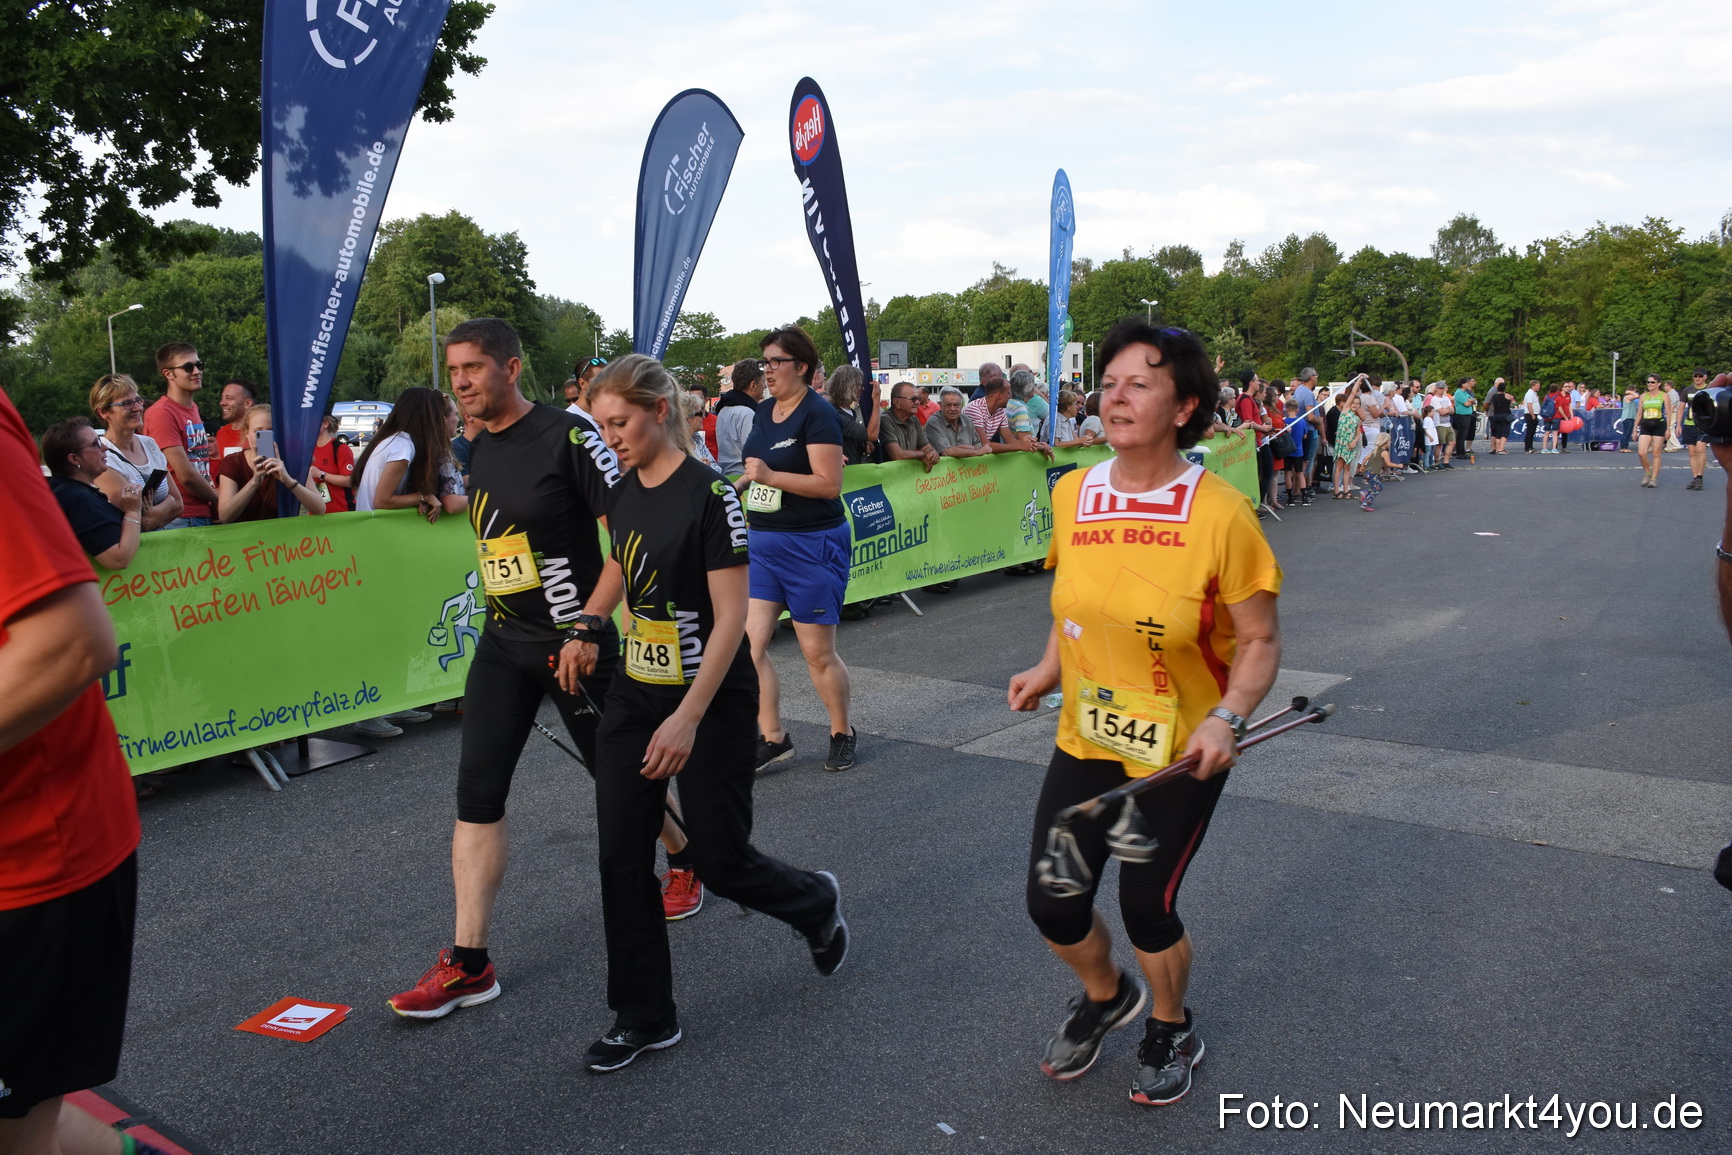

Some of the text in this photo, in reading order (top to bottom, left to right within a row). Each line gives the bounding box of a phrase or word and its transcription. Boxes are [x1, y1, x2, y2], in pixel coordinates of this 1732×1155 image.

[674, 122, 710, 201] Fischer
[688, 136, 715, 200] AUTOMOBILE
[301, 141, 386, 409] www.fischer-automobile.de
[749, 487, 776, 503] 1387
[857, 500, 884, 515] Fischer
[1071, 525, 1186, 547] MAX BÖGL
[242, 536, 334, 572] Firmen
[483, 556, 523, 581] 1751
[848, 560, 883, 580] eumarkt
[905, 546, 1006, 581] www.firmenlauf-oberpfalz.de
[266, 555, 362, 606] länger!
[630, 638, 670, 667] 1748
[1088, 708, 1158, 749] 1544
